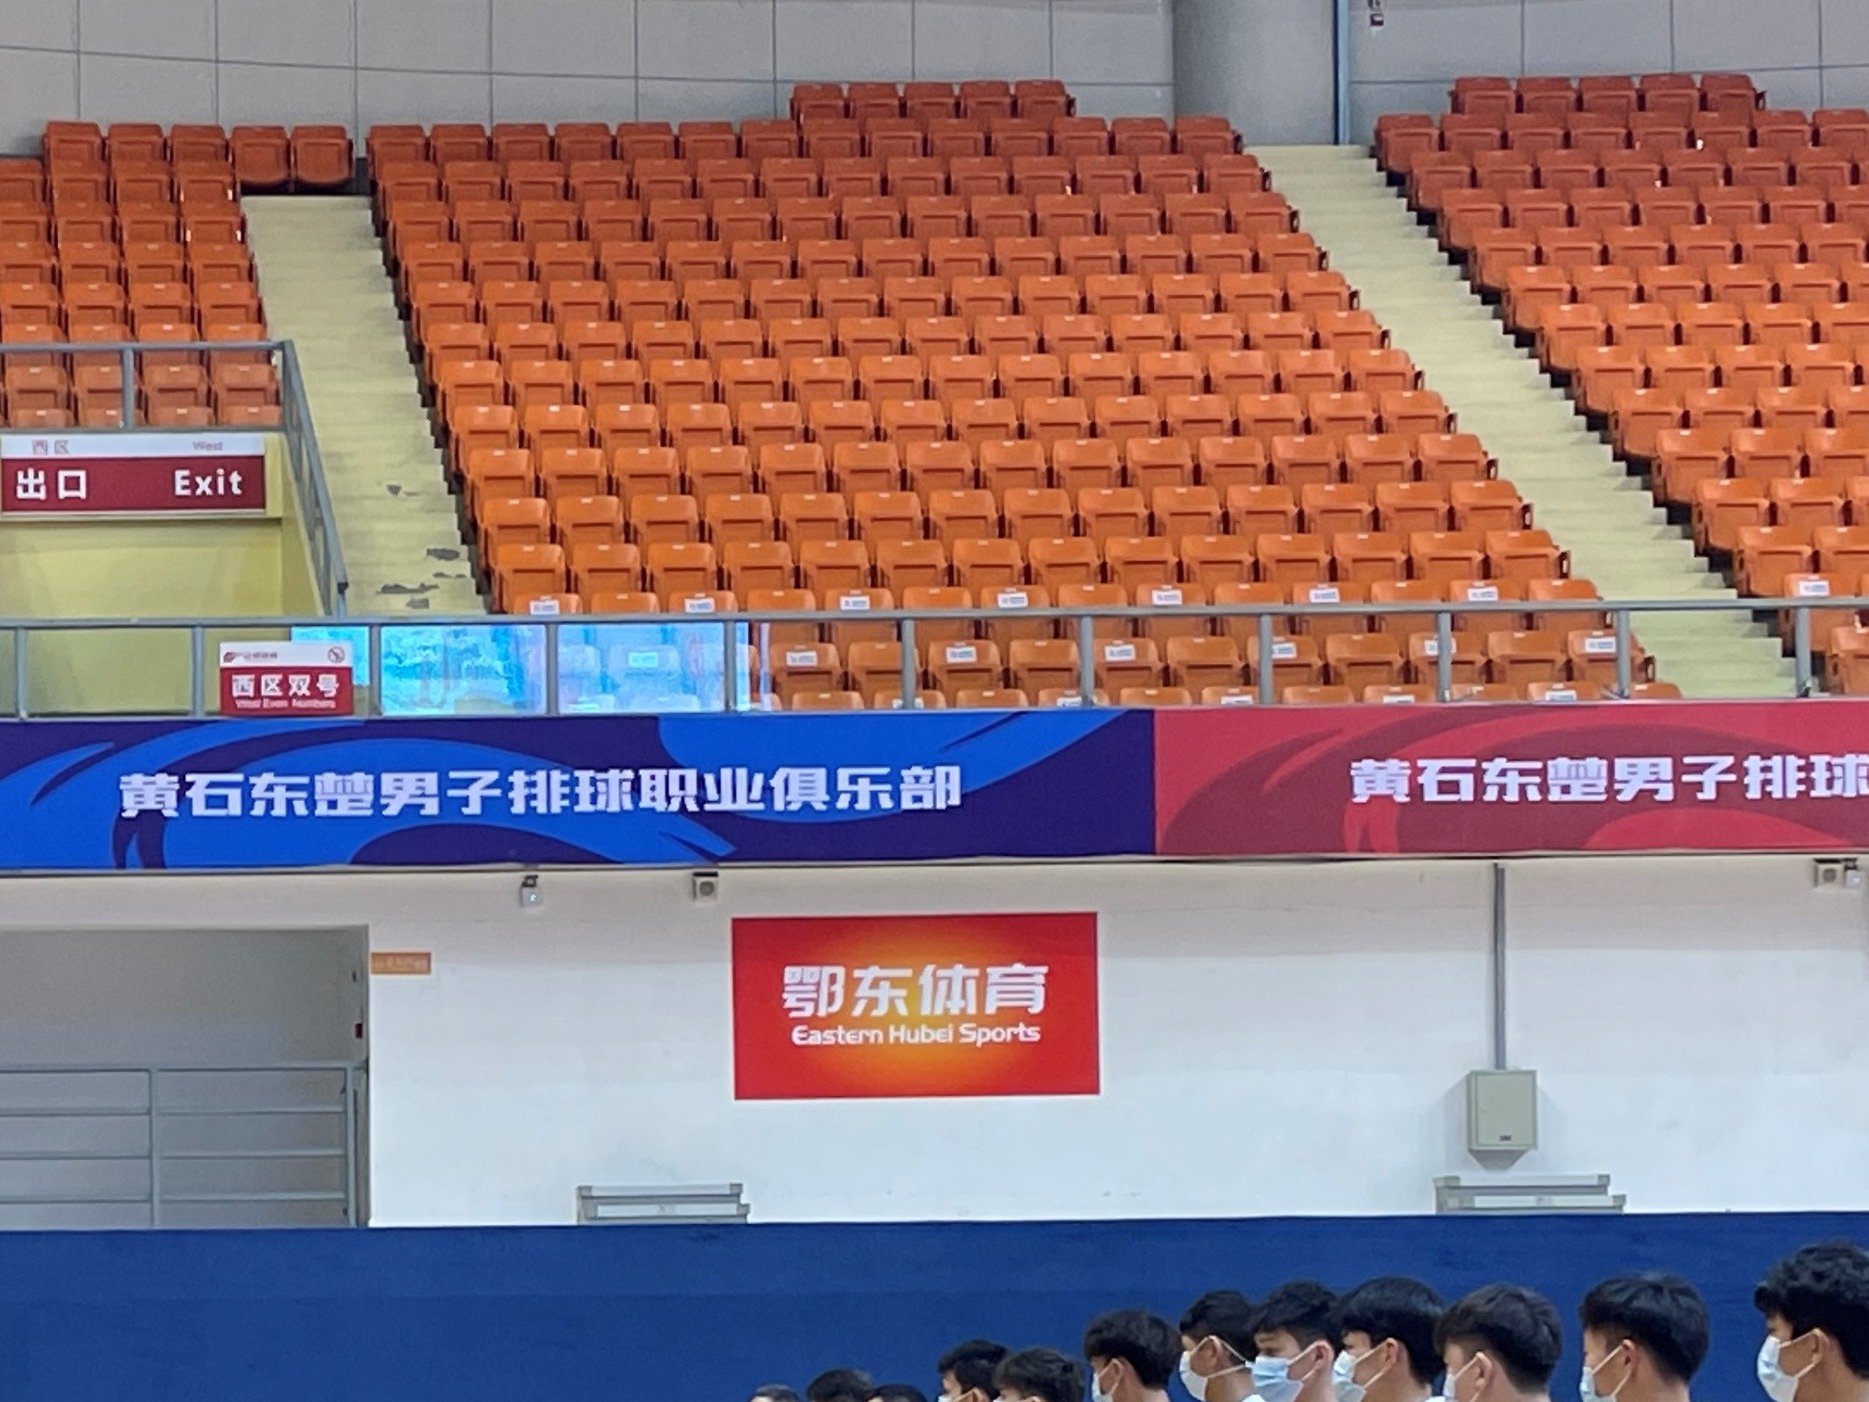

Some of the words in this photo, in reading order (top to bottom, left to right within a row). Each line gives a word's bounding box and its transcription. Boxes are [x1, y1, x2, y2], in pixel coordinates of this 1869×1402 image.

[16, 467, 87, 500] 出口
[174, 468, 243, 496] Exit
[232, 674, 339, 698] 西区双号
[119, 765, 962, 818] 黄石东楚男子排球职业俱乐部
[1350, 753, 1869, 803] 黄石东楚男子排球
[782, 963, 1049, 1019] 鄂东体育
[791, 1024, 883, 1046] Eastern
[889, 1023, 953, 1045] Hubei
[958, 1022, 1041, 1048] Sports
